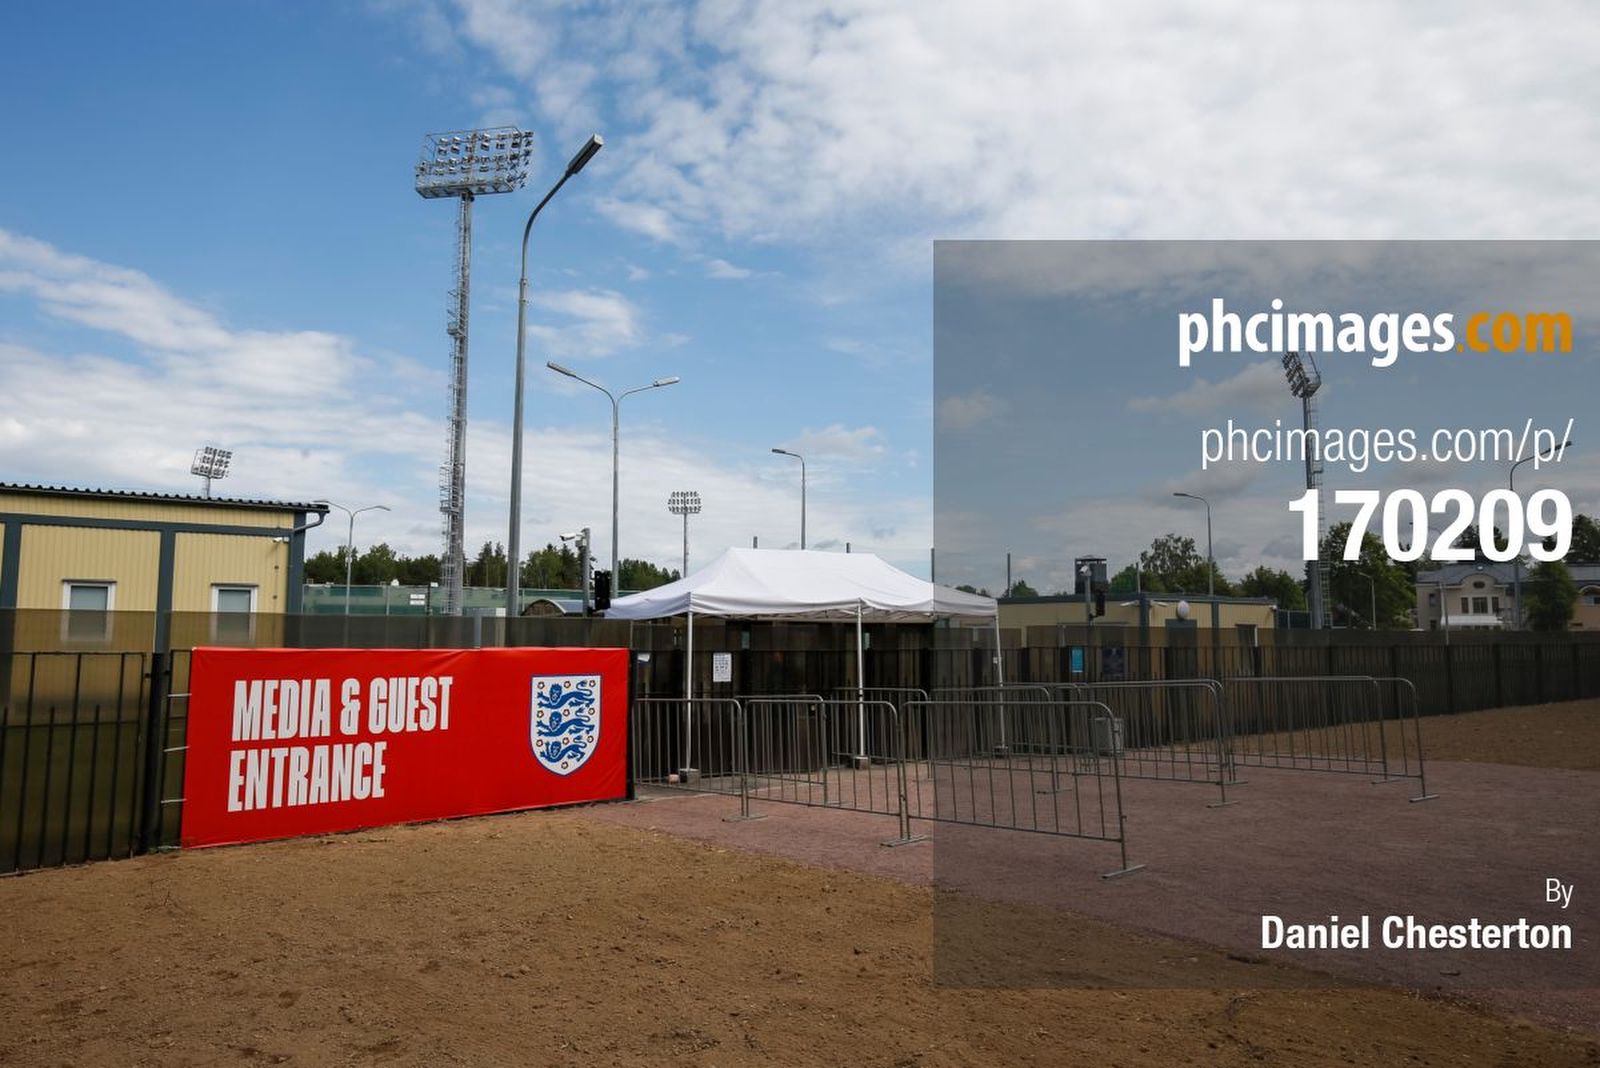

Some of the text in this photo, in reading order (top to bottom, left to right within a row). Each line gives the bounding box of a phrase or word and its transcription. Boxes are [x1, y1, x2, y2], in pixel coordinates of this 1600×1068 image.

[231, 675, 454, 742] MEDIA & GUEST
[227, 741, 387, 813] ENTRANCE
